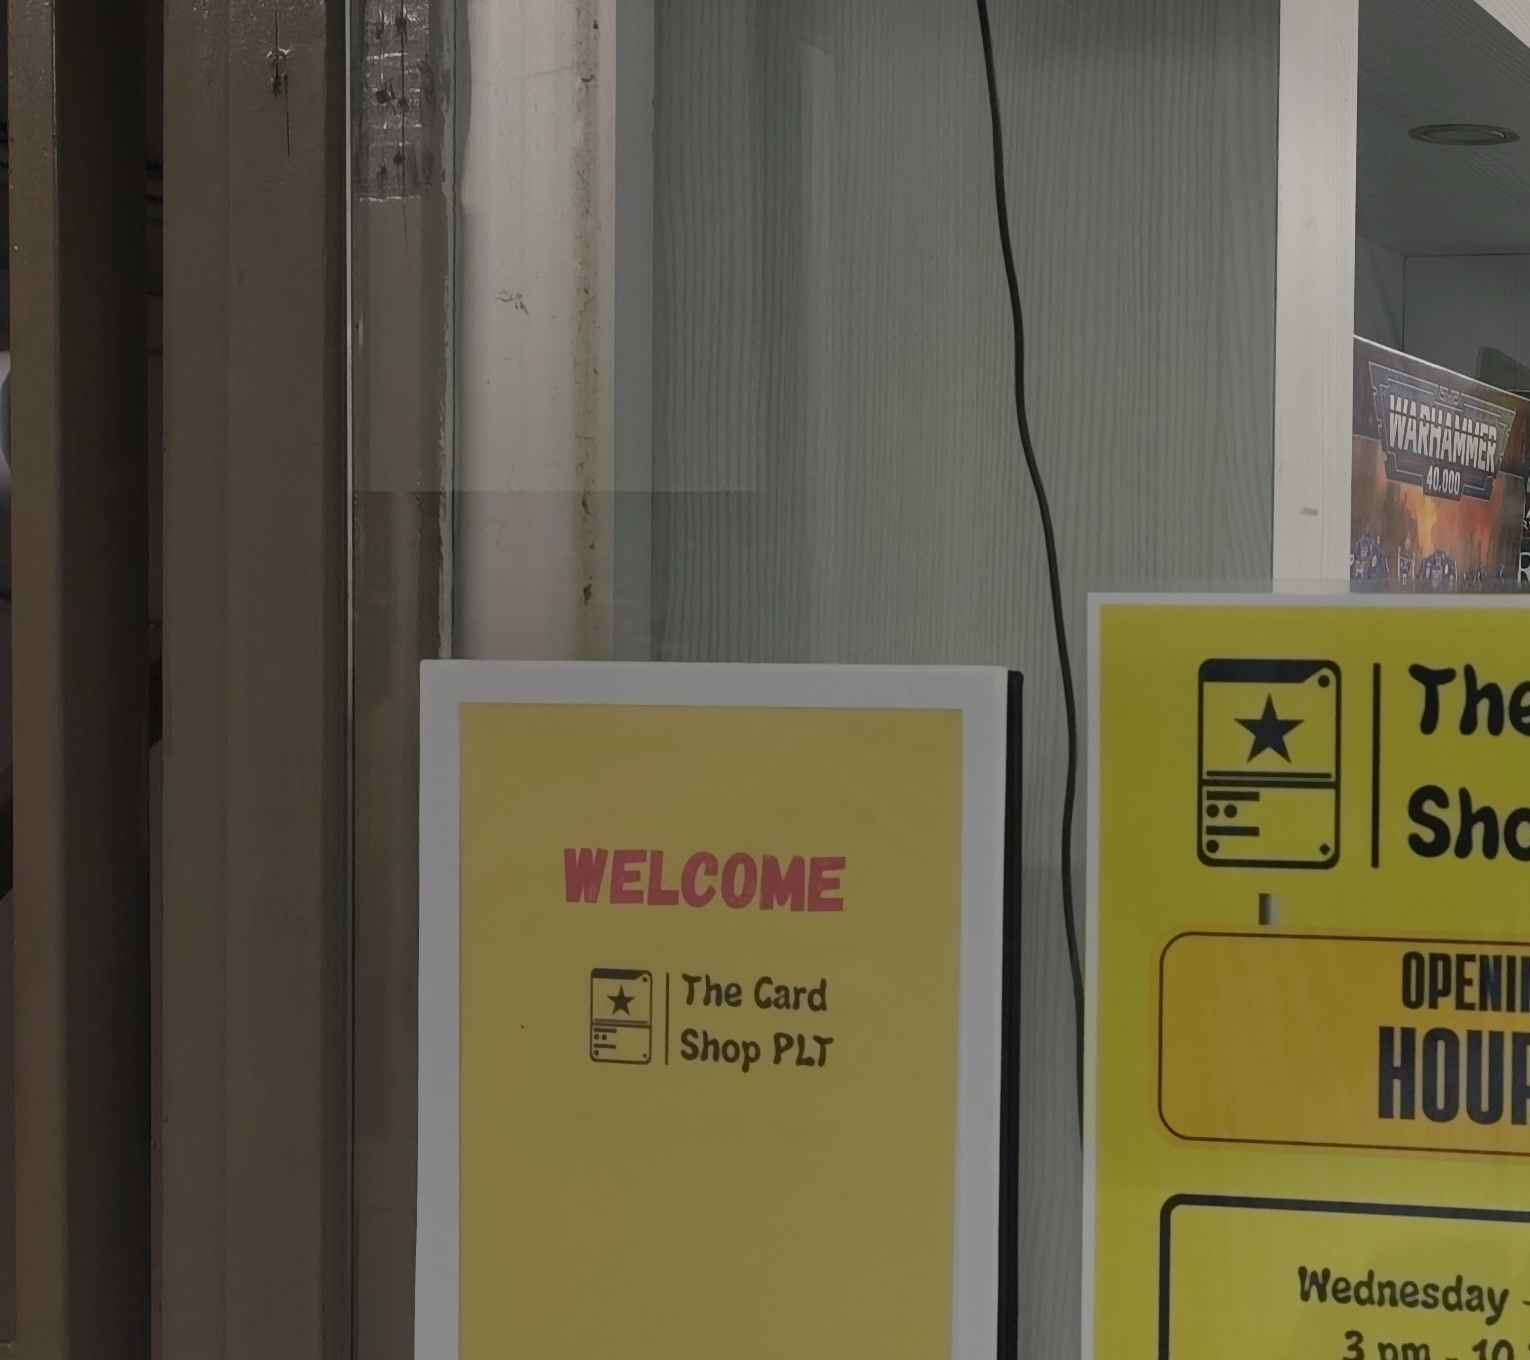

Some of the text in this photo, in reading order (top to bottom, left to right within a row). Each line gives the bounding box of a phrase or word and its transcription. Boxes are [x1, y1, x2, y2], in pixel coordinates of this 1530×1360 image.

[1389, 394, 1497, 473] WARHAMMER
[564, 847, 847, 912] WELCOME
[681, 973, 828, 1012] The Card
[681, 1028, 834, 1071] Shop PLT
[1298, 1266, 1509, 1325] Wednesday
